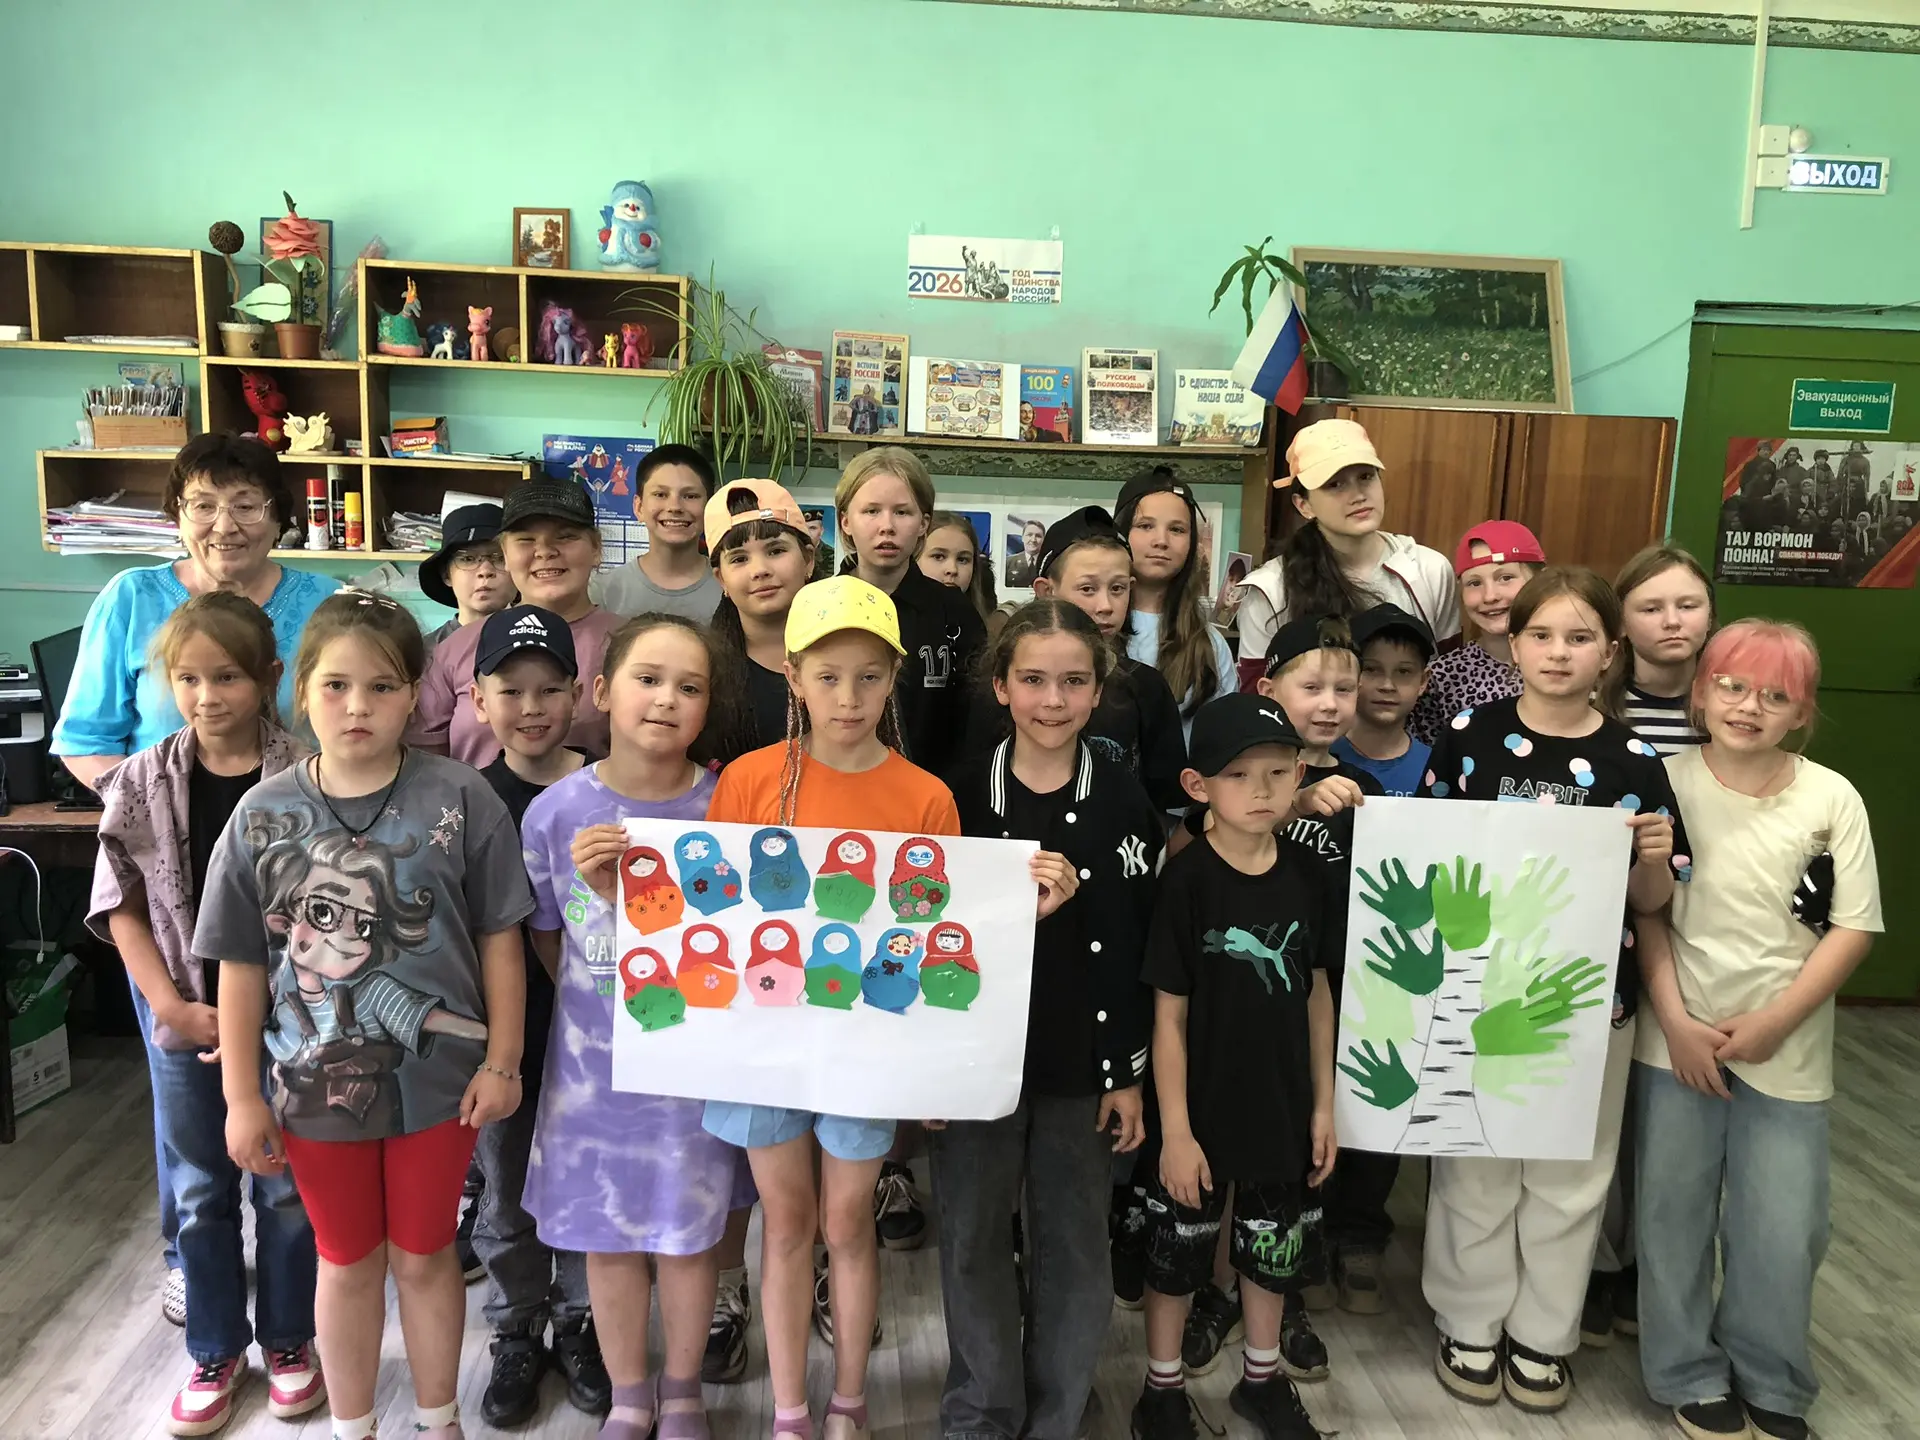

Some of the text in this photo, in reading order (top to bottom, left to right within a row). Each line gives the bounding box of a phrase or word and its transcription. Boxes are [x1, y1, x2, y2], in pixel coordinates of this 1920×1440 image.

[1012, 269, 1031, 278] ГОД
[908, 271, 963, 294] 2026
[1012, 278, 1060, 287] ЕДИНСТВА
[1012, 287, 1056, 296] НАРОДОВ
[1012, 295, 1050, 304] РОССИИ
[1026, 375, 1055, 391] 100
[1105, 373, 1137, 381] РУССКИЕ
[1179, 374, 1186, 389] В
[1190, 377, 1229, 390] единстве
[1097, 380, 1146, 390] ПОЛКОВОДЦЫ
[1197, 392, 1245, 404] наша сила
[1796, 389, 1890, 405] Эвакуационный
[1820, 407, 1862, 420] выход
[1726, 531, 1814, 548] ТАУ ВОРМОН
[1723, 548, 1843, 564] ПОННА! СПАСИБО ЗА ПОБЕДУ!
[509, 626, 548, 637] adidas
[918, 645, 950, 677] 11
[1499, 777, 1589, 806] RABBIT
[1116, 834, 1149, 879] NY
